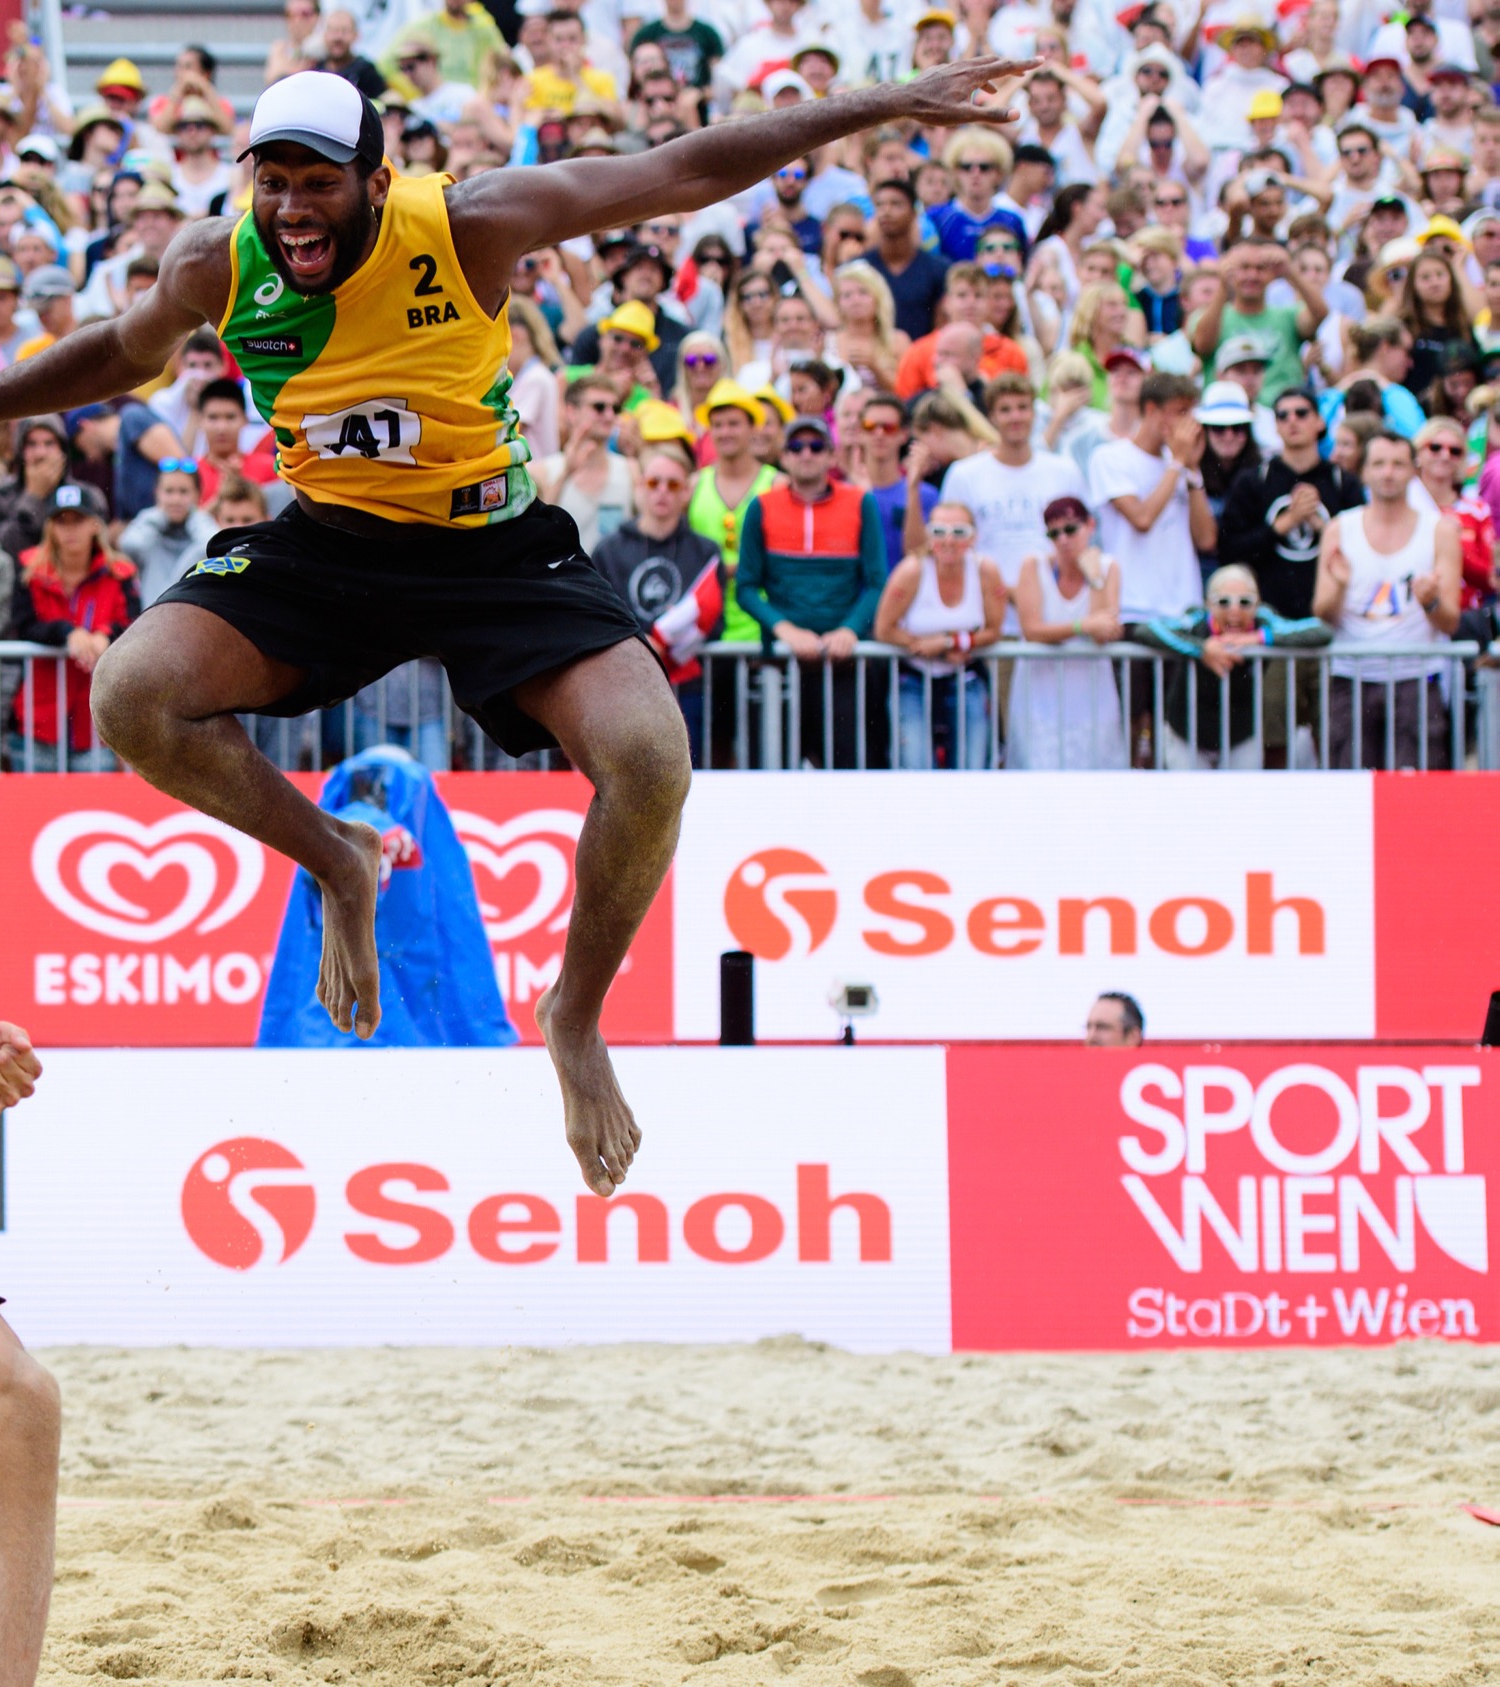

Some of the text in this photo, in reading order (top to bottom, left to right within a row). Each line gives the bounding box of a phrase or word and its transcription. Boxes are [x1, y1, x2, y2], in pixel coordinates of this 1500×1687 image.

[409, 254, 443, 297] 2
[246, 339, 288, 351] swatch
[406, 301, 460, 329] BRA
[861, 869, 1326, 957] Senoh
[34, 953, 261, 1005] ESKIMO
[1118, 1064, 1481, 1175] SPORT
[343, 1162, 892, 1265] Senoh
[1120, 1175, 1416, 1273] WIEN
